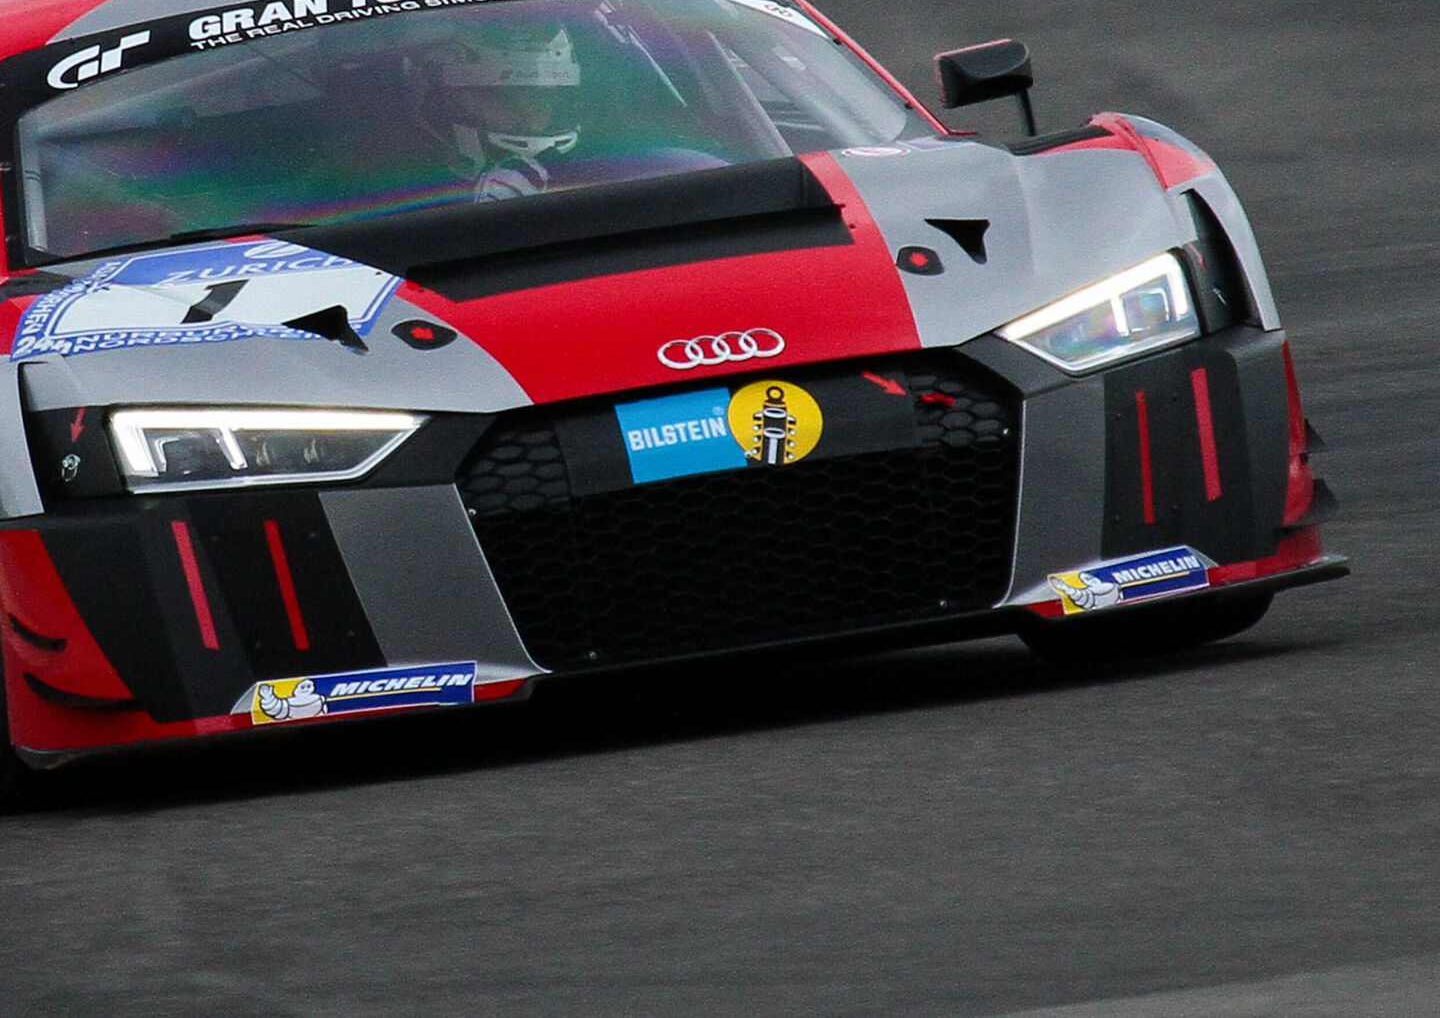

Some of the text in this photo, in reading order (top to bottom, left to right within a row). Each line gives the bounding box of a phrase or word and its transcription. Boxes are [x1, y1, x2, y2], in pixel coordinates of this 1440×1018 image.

[190, 32, 244, 51] THE
[247, 18, 314, 40] REAL
[316, 0, 421, 24] DRIVING
[627, 416, 728, 452] BILSTEIN
[1111, 555, 1201, 584] MICHELIN
[329, 673, 473, 697] MICHELIN
